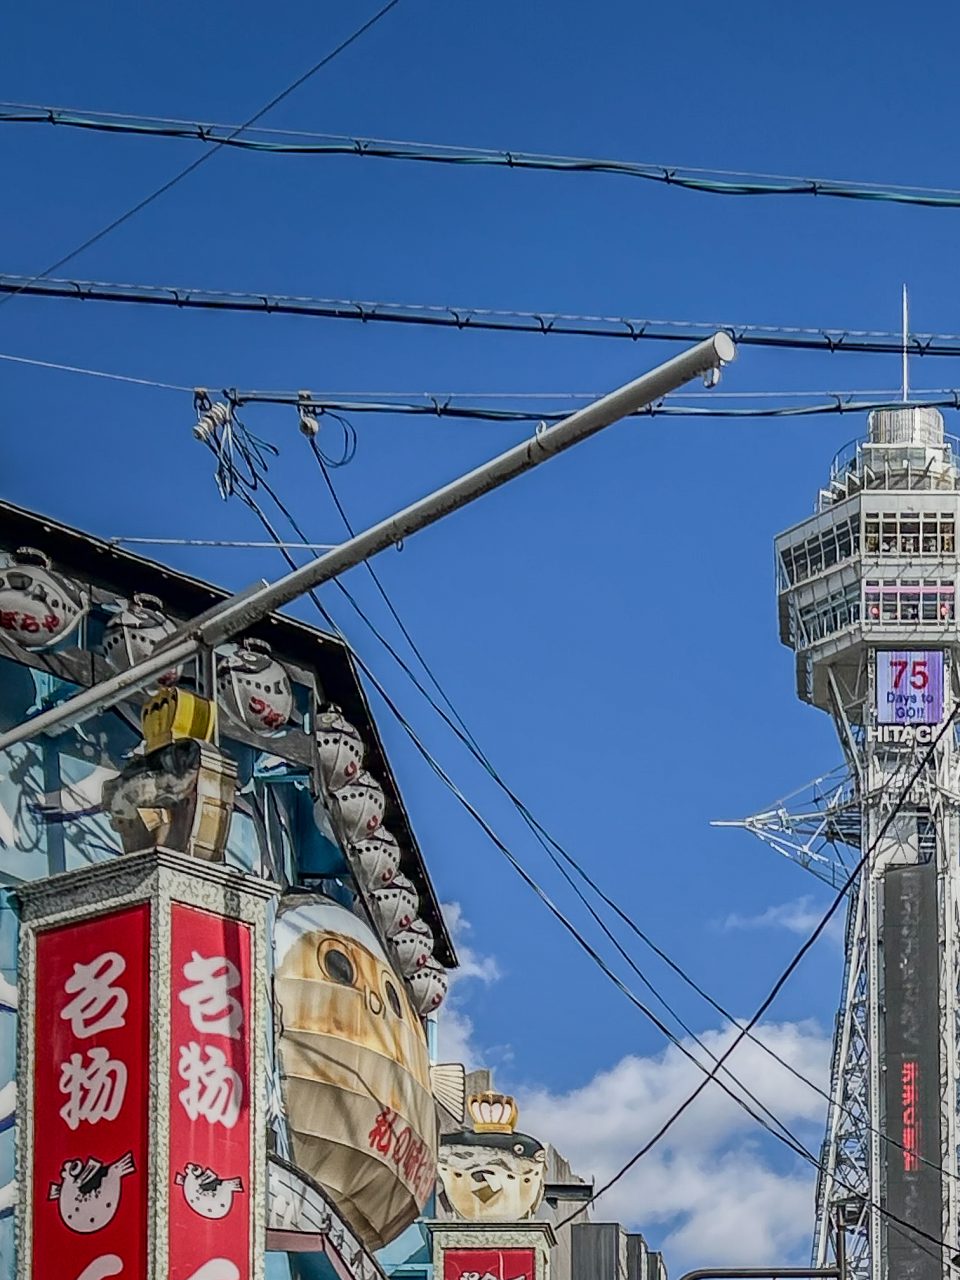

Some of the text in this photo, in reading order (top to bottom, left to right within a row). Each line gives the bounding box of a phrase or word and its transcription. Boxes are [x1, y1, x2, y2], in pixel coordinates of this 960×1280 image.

[889, 660, 930, 690] 75
[886, 691, 934, 705] Days to
[895, 706, 925, 719] GO!!
[59, 951, 129, 1130] 名物
[177, 950, 244, 1129] 名物
